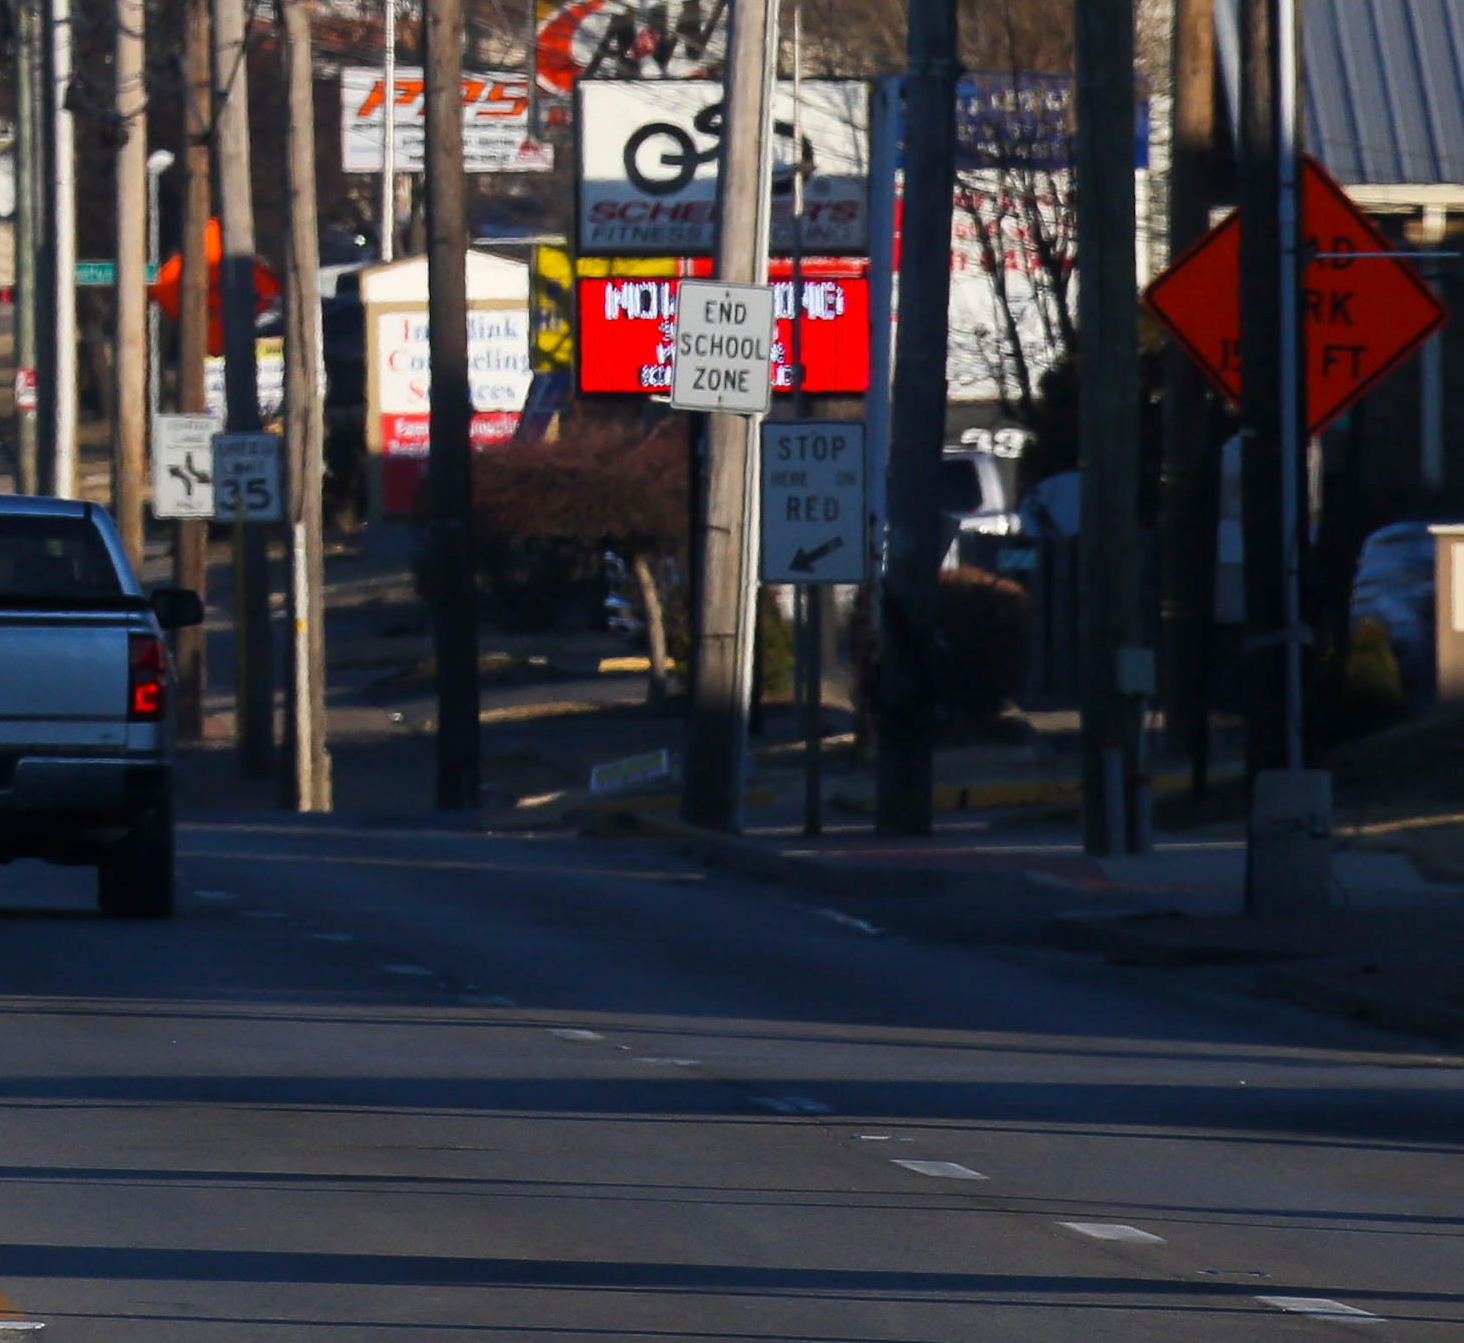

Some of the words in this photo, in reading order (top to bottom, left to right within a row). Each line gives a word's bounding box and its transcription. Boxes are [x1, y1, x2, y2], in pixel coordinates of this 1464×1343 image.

[704, 300, 747, 325] END
[1303, 289, 1354, 326] RK
[679, 333, 767, 361] SCHOOL
[1322, 345, 1368, 379] FT
[692, 367, 751, 393] ZONE
[777, 436, 846, 461] STOP
[218, 478, 272, 513] 35
[786, 495, 841, 522] RED
